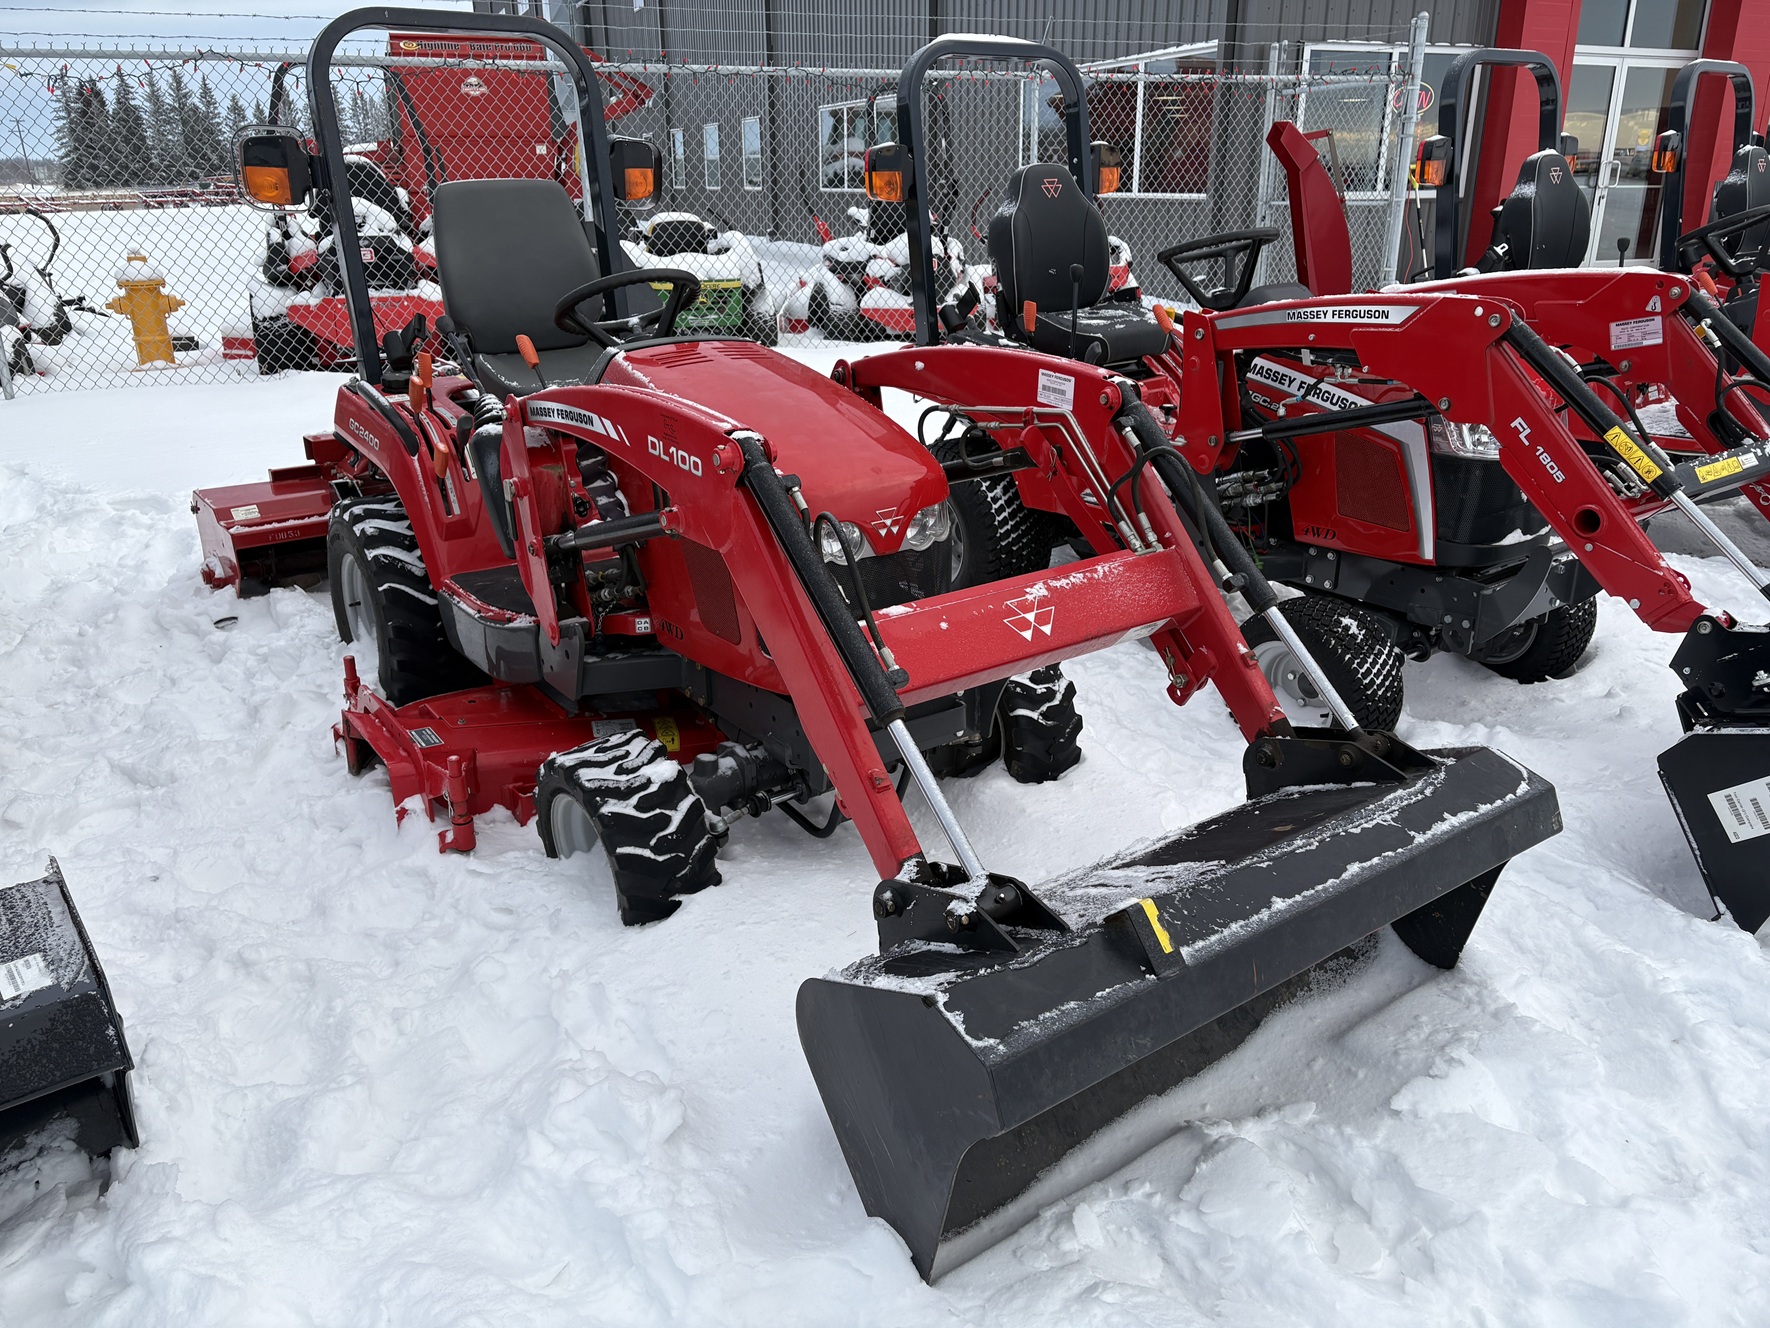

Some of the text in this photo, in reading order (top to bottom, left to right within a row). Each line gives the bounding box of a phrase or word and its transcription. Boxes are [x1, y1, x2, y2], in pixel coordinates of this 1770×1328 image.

[1287, 309, 1390, 321] MASSEY FERGUSON
[1250, 363, 1297, 388] MASSEY
[529, 406, 594, 427] MASSEY FERGUSON
[348, 417, 380, 451] GC2400
[647, 435, 702, 477] DL100
[1510, 416, 1566, 483] FL 1805
[1301, 525, 1337, 541] 4WD
[659, 619, 684, 640] 4WD
